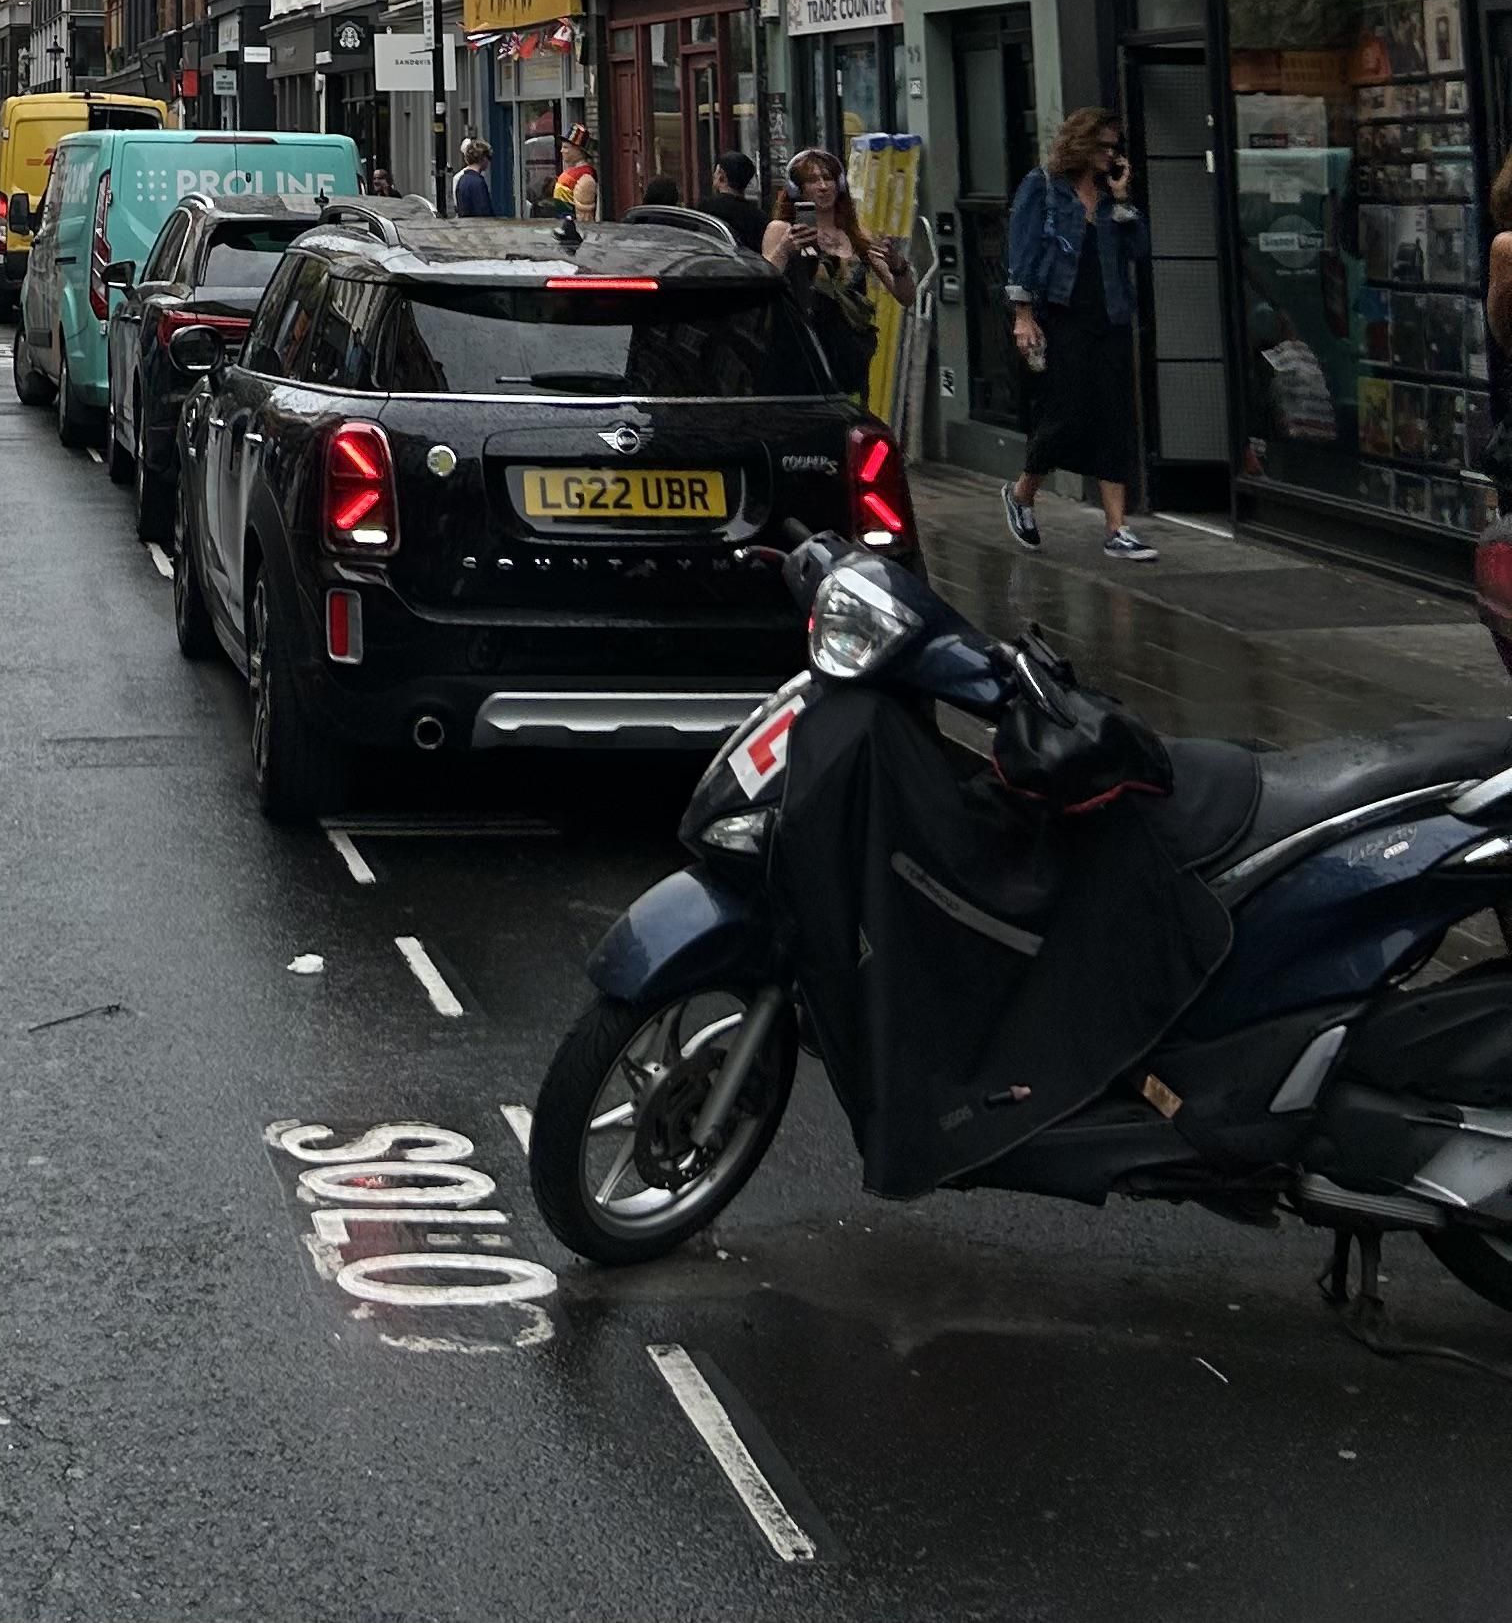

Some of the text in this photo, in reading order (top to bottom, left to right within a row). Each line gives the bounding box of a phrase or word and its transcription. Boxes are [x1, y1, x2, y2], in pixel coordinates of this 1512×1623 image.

[541, 476, 710, 511] LG22 UBR
[278, 1122, 558, 1306] SOLO
